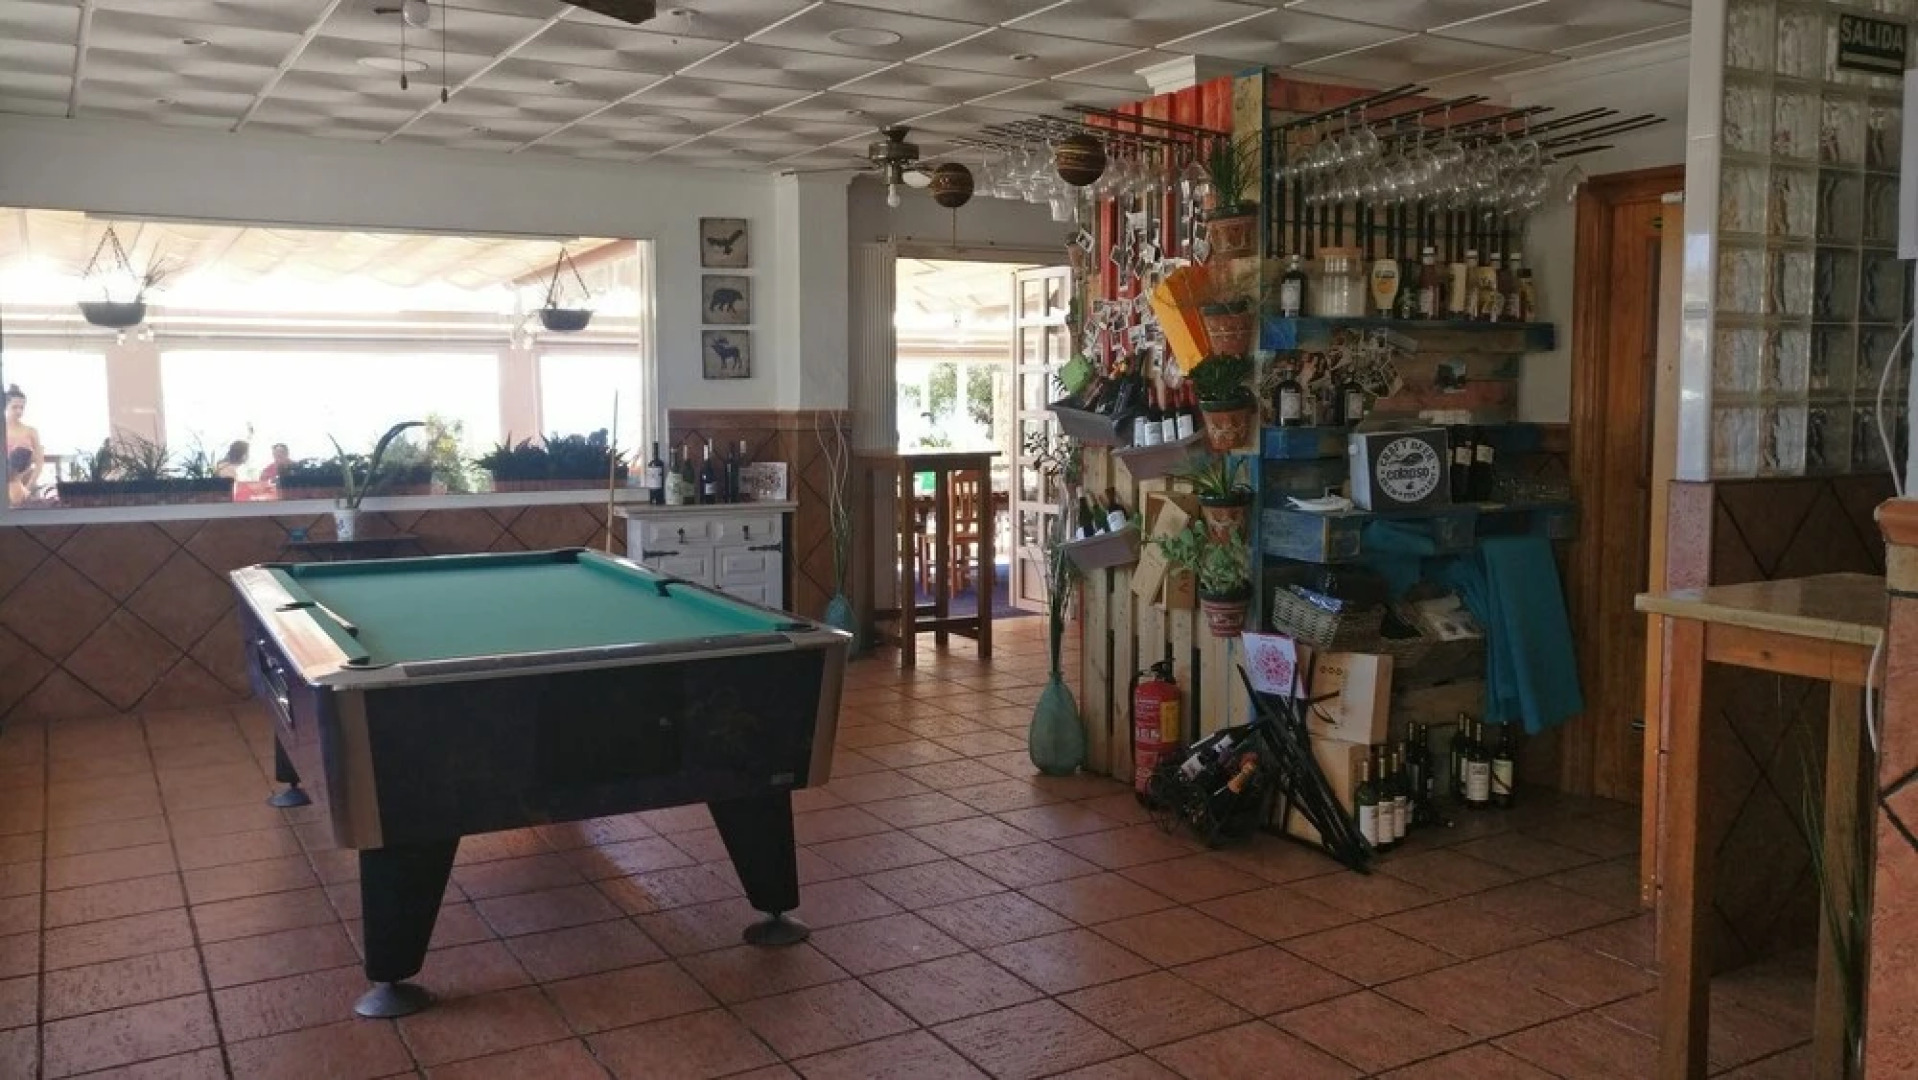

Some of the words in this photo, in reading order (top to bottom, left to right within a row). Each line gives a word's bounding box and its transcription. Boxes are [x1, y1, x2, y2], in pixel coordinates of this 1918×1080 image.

[1841, 17, 1903, 52] SALIDA
[1381, 440, 1407, 466] CRAFT
[1410, 440, 1436, 462] BEER
